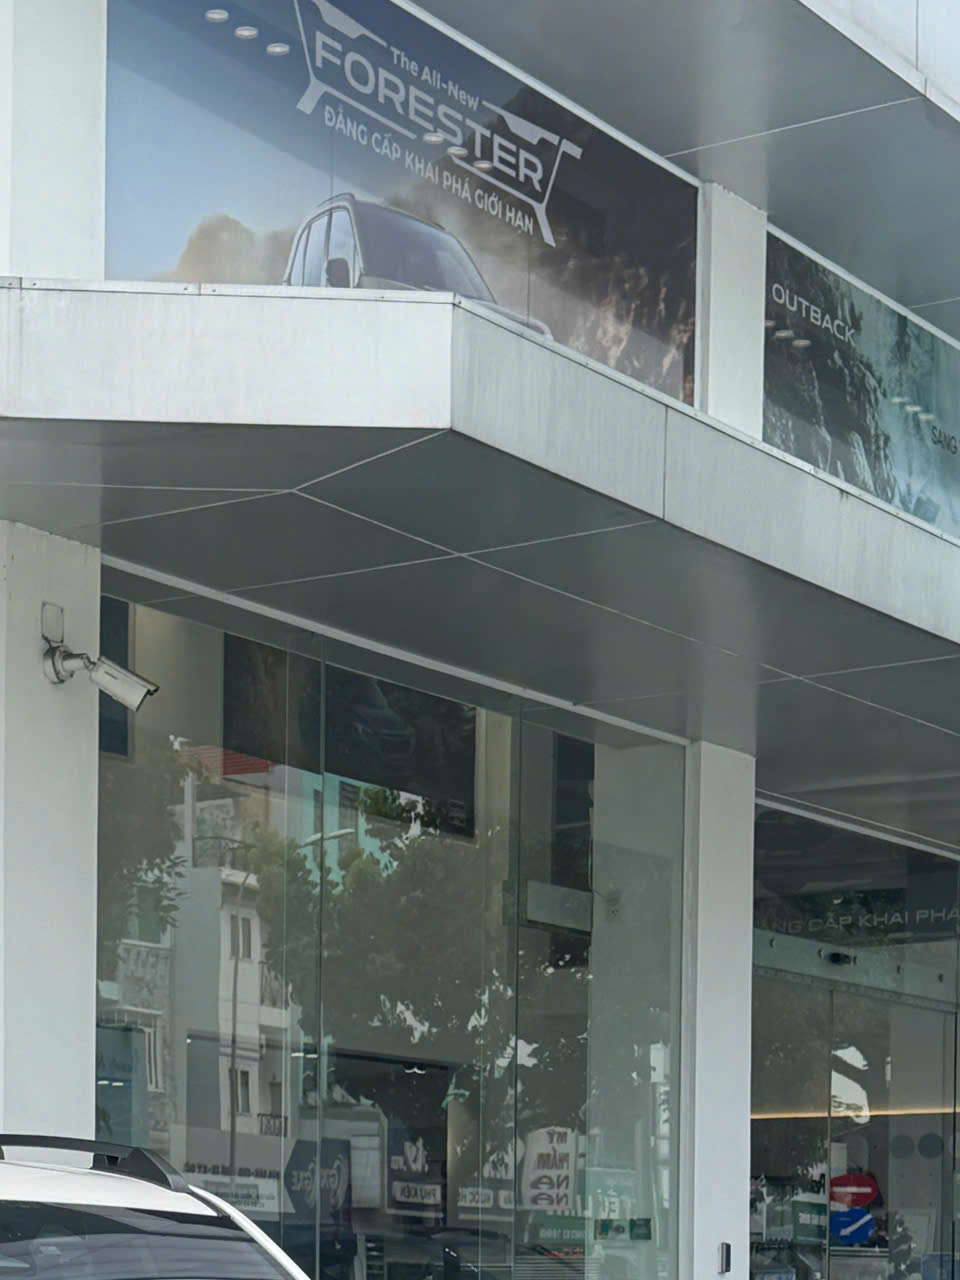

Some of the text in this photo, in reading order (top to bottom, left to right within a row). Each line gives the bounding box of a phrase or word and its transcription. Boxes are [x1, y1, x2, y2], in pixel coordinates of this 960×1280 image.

[389, 45, 482, 111] The All-New
[314, 31, 544, 192] FORESTER
[371, 132, 402, 161] CẤP
[404, 149, 440, 185] KHAI
[442, 171, 473, 204] PHÁ
[474, 187, 504, 218] GIỚI
[505, 202, 536, 236] HẠN
[771, 282, 857, 348] OUTBACK
[858, 911, 909, 930] KHAI
